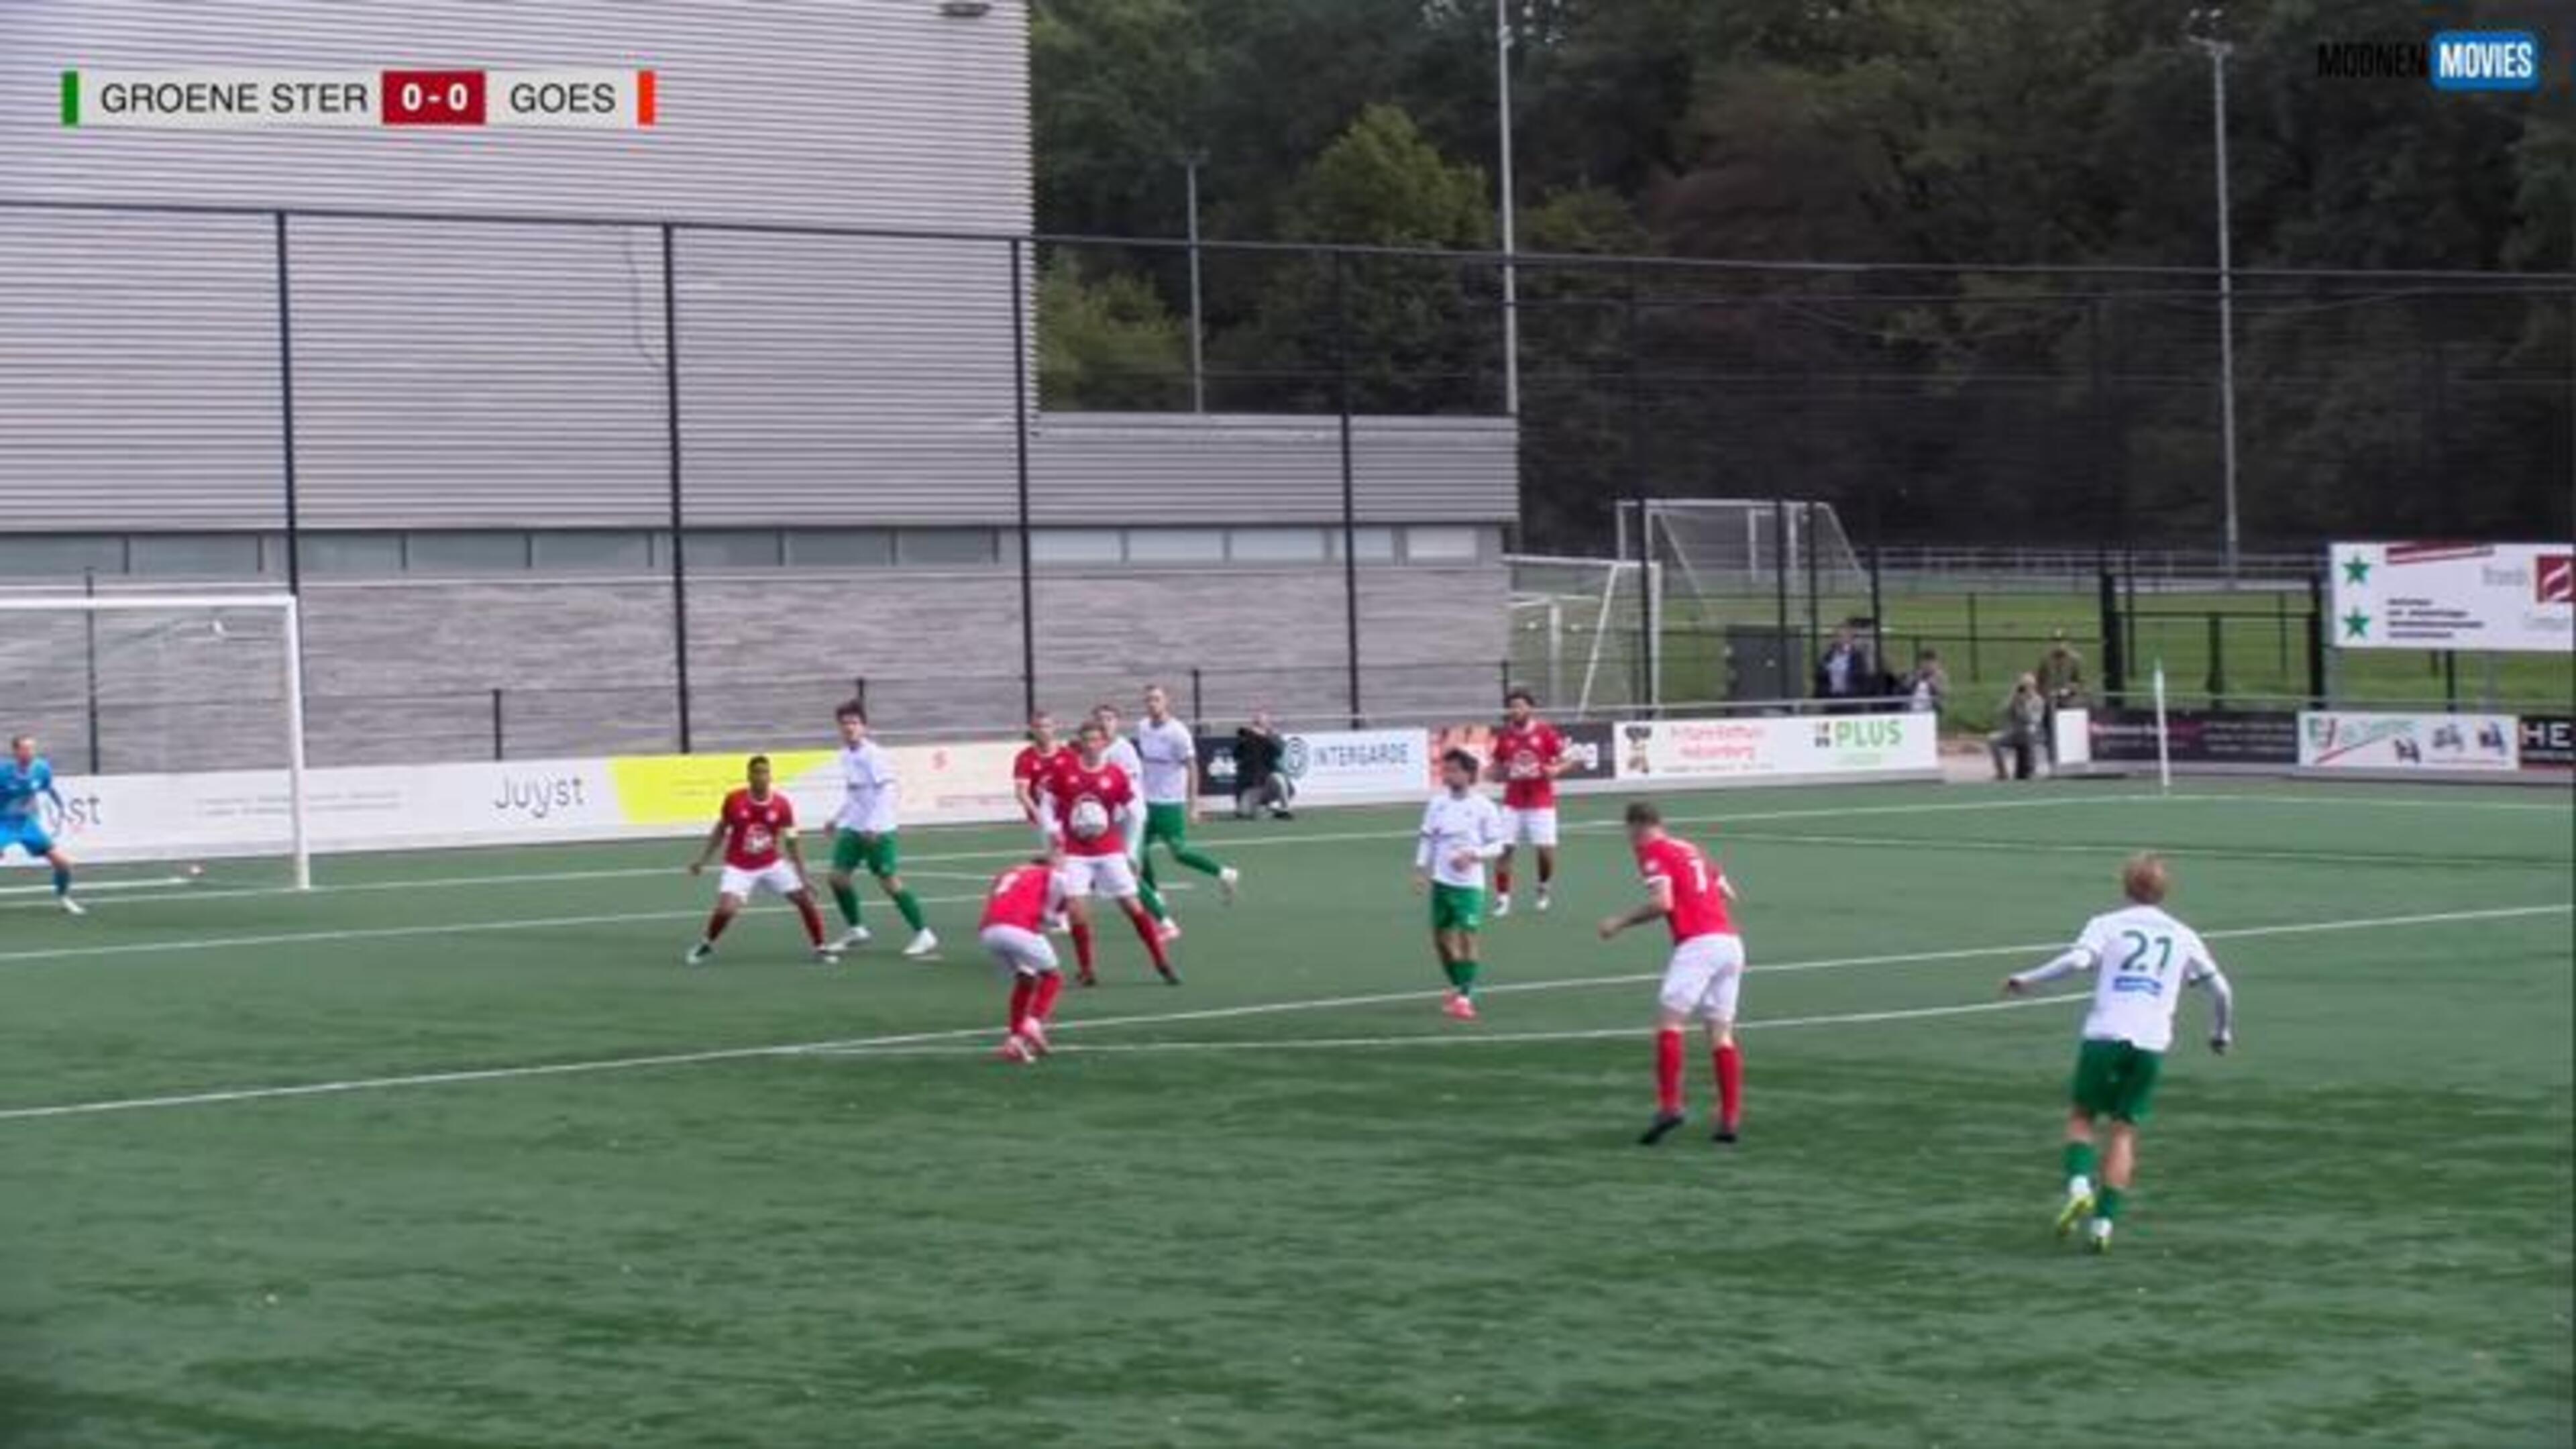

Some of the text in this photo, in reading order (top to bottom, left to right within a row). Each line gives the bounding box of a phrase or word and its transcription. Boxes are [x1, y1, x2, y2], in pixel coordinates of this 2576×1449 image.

[1835, 720, 1902, 747] PLUS
[1316, 743, 1409, 767] INTERGARDE
[494, 775, 584, 818] Juyst
